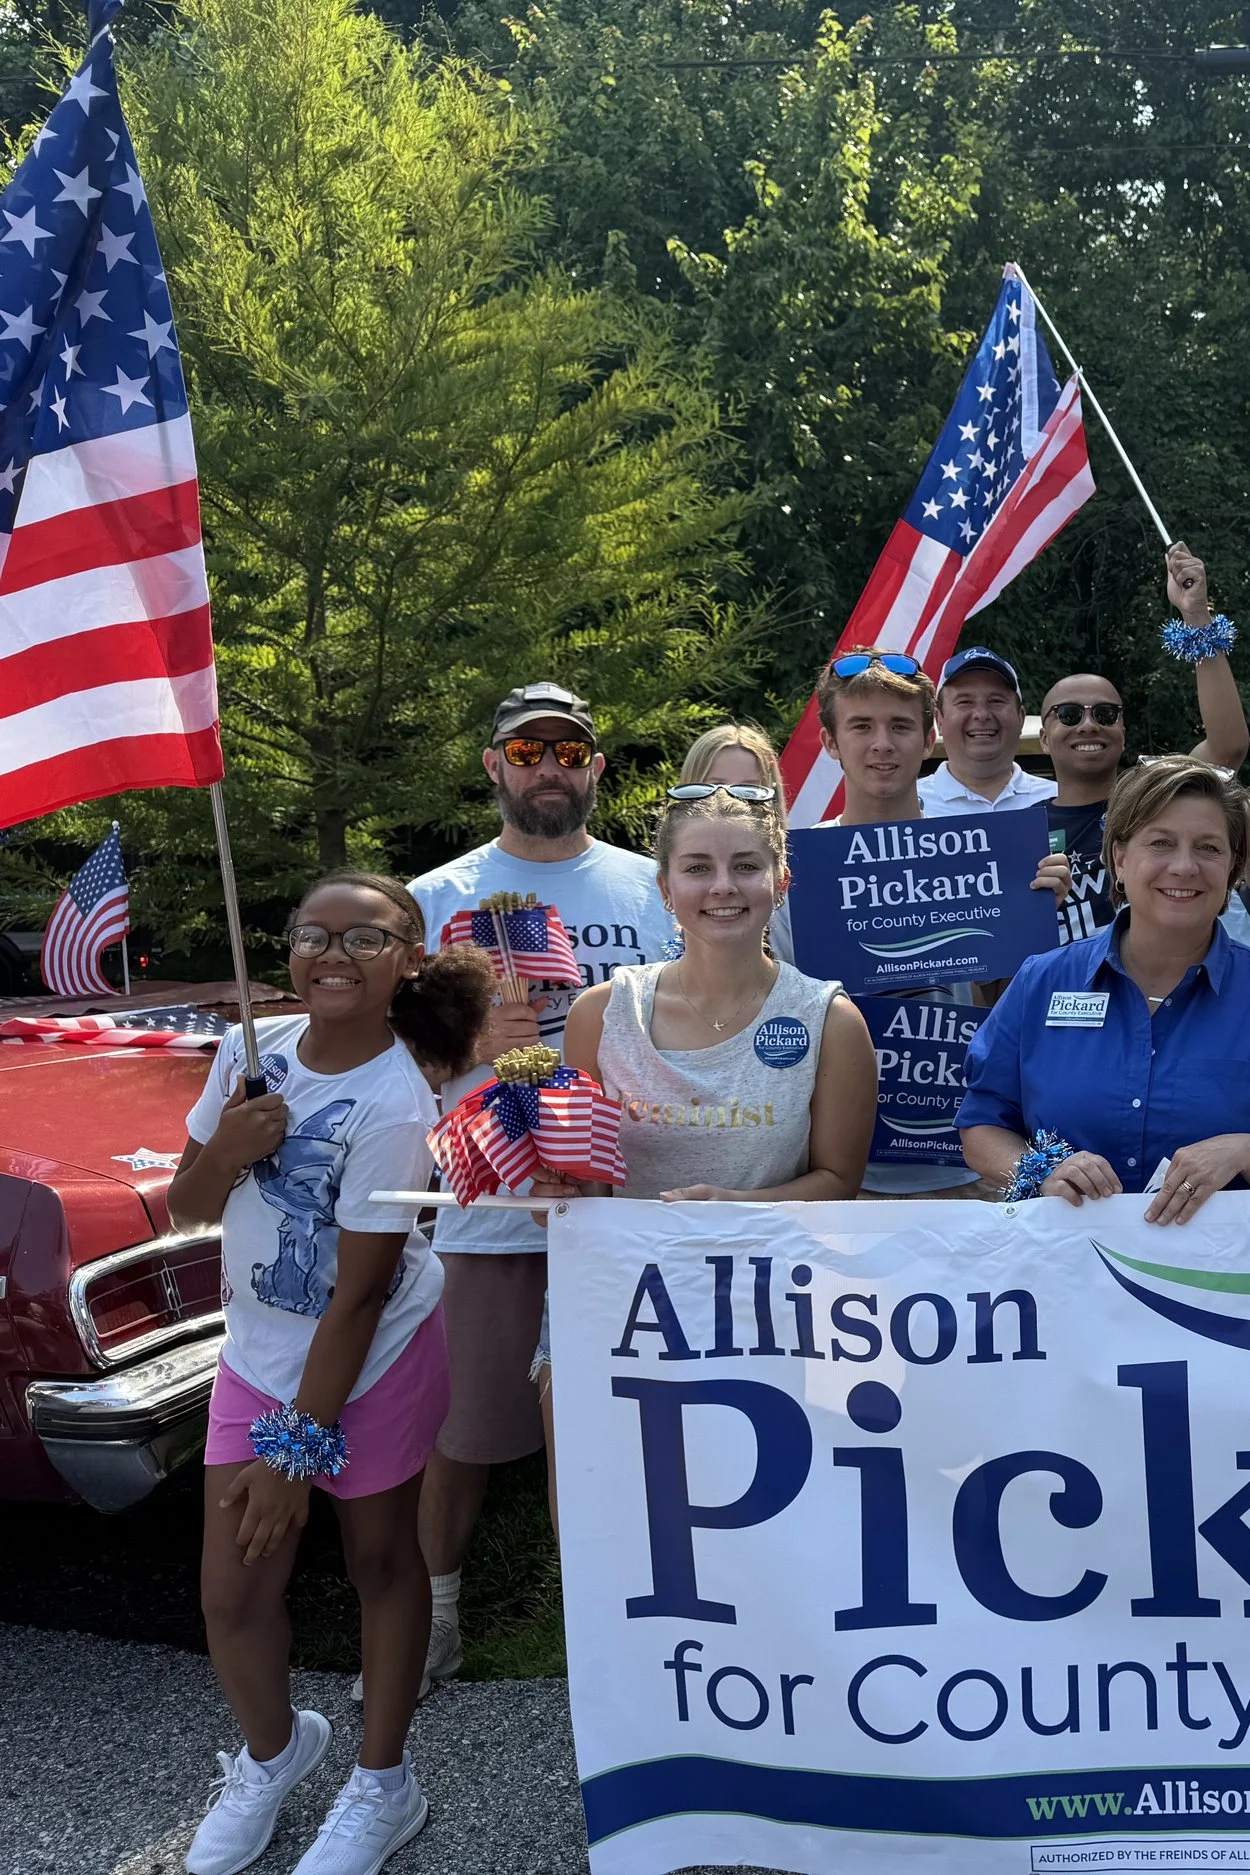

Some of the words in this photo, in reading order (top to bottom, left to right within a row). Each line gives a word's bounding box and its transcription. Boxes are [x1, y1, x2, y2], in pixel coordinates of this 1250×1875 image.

[844, 826, 991, 864] Allison
[838, 861, 1003, 909] Pickard
[847, 919, 868, 931] for
[872, 912, 926, 929] County
[930, 906, 1001, 924] Executive
[876, 956, 978, 974] AllisonPickard.com
[1051, 1000, 1105, 1011] Pickard
[759, 1024, 805, 1035] Allison
[883, 1006, 978, 1044] Allis
[755, 1035, 807, 1046] Pickard
[259, 1055, 286, 1081] Allison
[875, 1049, 968, 1088] Pick
[877, 1093, 892, 1103] or
[896, 1093, 950, 1109] County
[890, 1139, 963, 1151] AllisonPickar
[611, 1256, 1046, 1365] Allison
[664, 1640, 814, 1735] for
[1038, 1851, 1113, 1863] AUTHORIZED
[1118, 1851, 1132, 1860] BY
[1134, 1851, 1156, 1860] THE
[1159, 1850, 1208, 1860] FREINDS
[1211, 1850, 1227, 1860] OF
